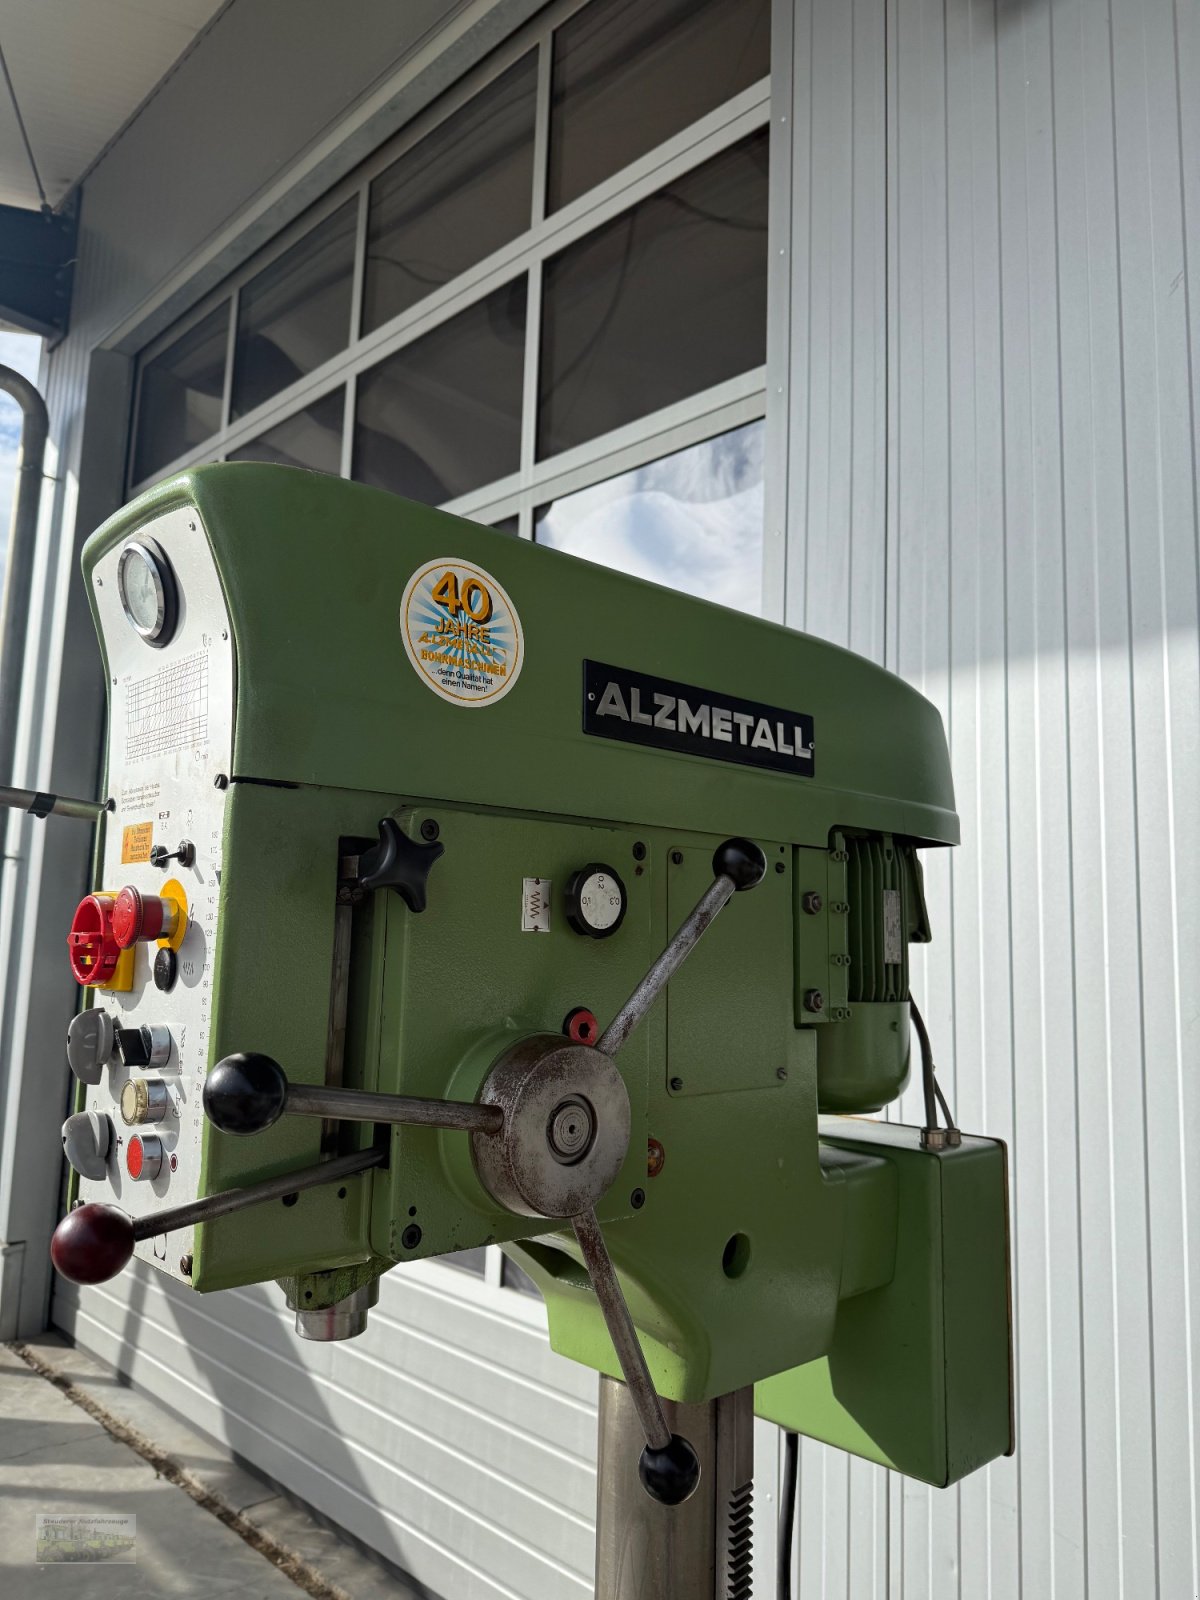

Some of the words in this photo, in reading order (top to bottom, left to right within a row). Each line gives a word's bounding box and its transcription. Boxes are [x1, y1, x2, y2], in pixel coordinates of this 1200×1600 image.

[432, 571, 493, 625] 40
[418, 631, 494, 657] ALZMETALL
[434, 617, 491, 644] JAHRE
[420, 649, 507, 677] BOHRMASCHINEN
[441, 678, 461, 688] einen
[461, 681, 489, 693] Namen!
[482, 674, 494, 686] hat
[596, 681, 812, 760] ALZMETALL
